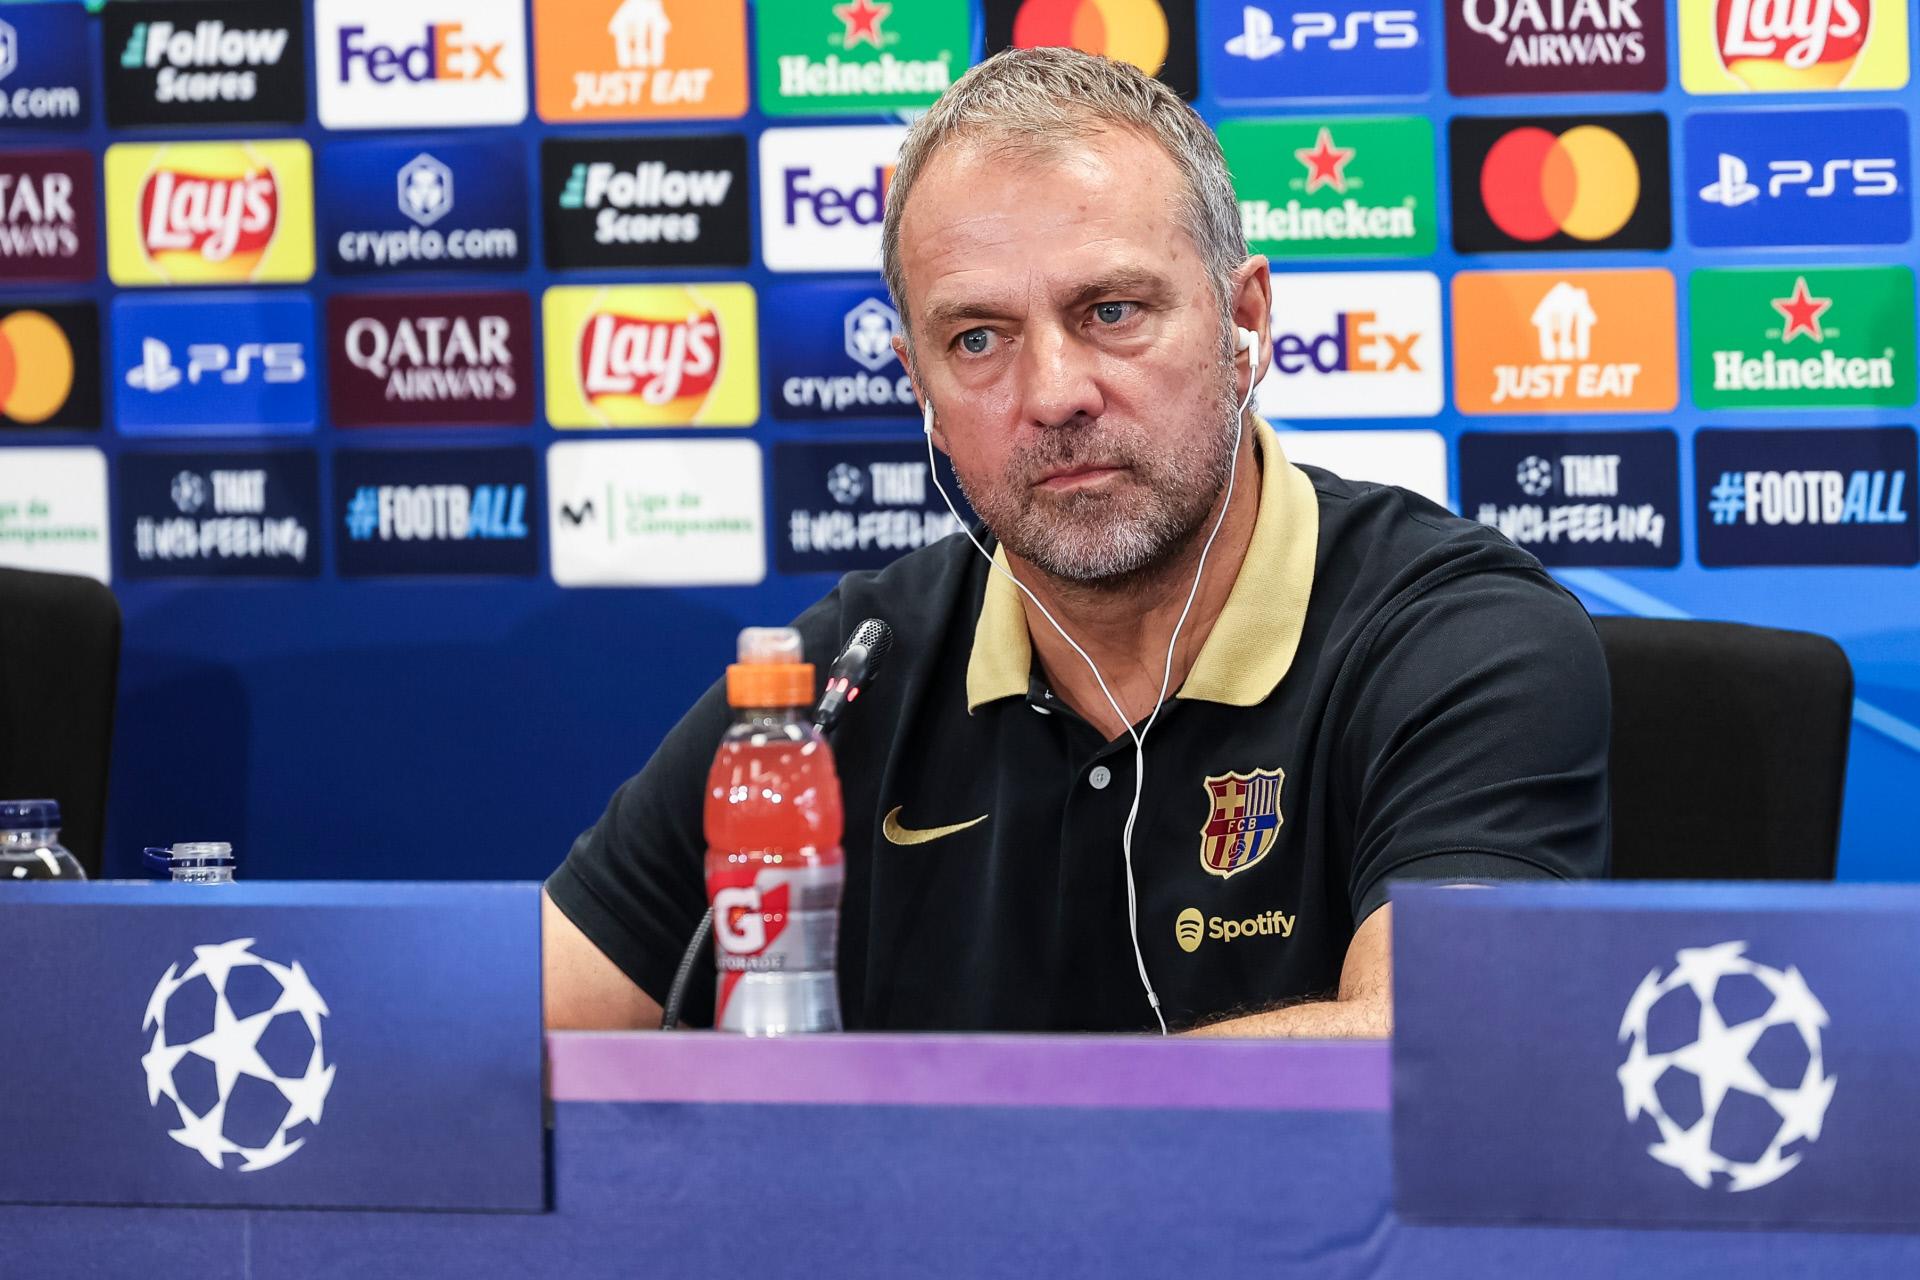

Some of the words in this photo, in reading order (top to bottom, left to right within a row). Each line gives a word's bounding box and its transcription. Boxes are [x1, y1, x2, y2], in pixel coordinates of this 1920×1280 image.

[145, 21, 288, 68] Follow
[1292, 10, 1419, 51] PS5
[1505, 32, 1646, 67] AIRWAYS
[338, 24, 505, 84] FedEx
[778, 52, 949, 97] Heineken
[156, 68, 257, 102] Scores
[572, 72, 646, 110] JUST
[651, 69, 711, 102] EAT
[585, 162, 732, 208] Follow
[784, 165, 896, 226] Fed
[1768, 159, 1898, 198] PS5
[147, 168, 275, 264] Lay's
[595, 208, 700, 244] Scores
[1240, 199, 1416, 240] Heineken
[338, 226, 518, 266] crypto.com
[187, 343, 305, 384] PS5
[344, 315, 512, 378] QATAR
[585, 312, 717, 404] Lay's
[1271, 311, 1423, 375] edEx
[385, 366, 516, 400] AIRWAYS
[1492, 366, 1571, 403] JUST
[1576, 363, 1641, 397] EAT
[1713, 349, 1894, 390] Heineken
[783, 371, 915, 412] crypto.c
[1560, 455, 1620, 497] THAT
[345, 484, 528, 540] #FOOTBALL
[1709, 470, 1907, 526] #FOOTBALL
[1208, 910, 1296, 942] Spotify
